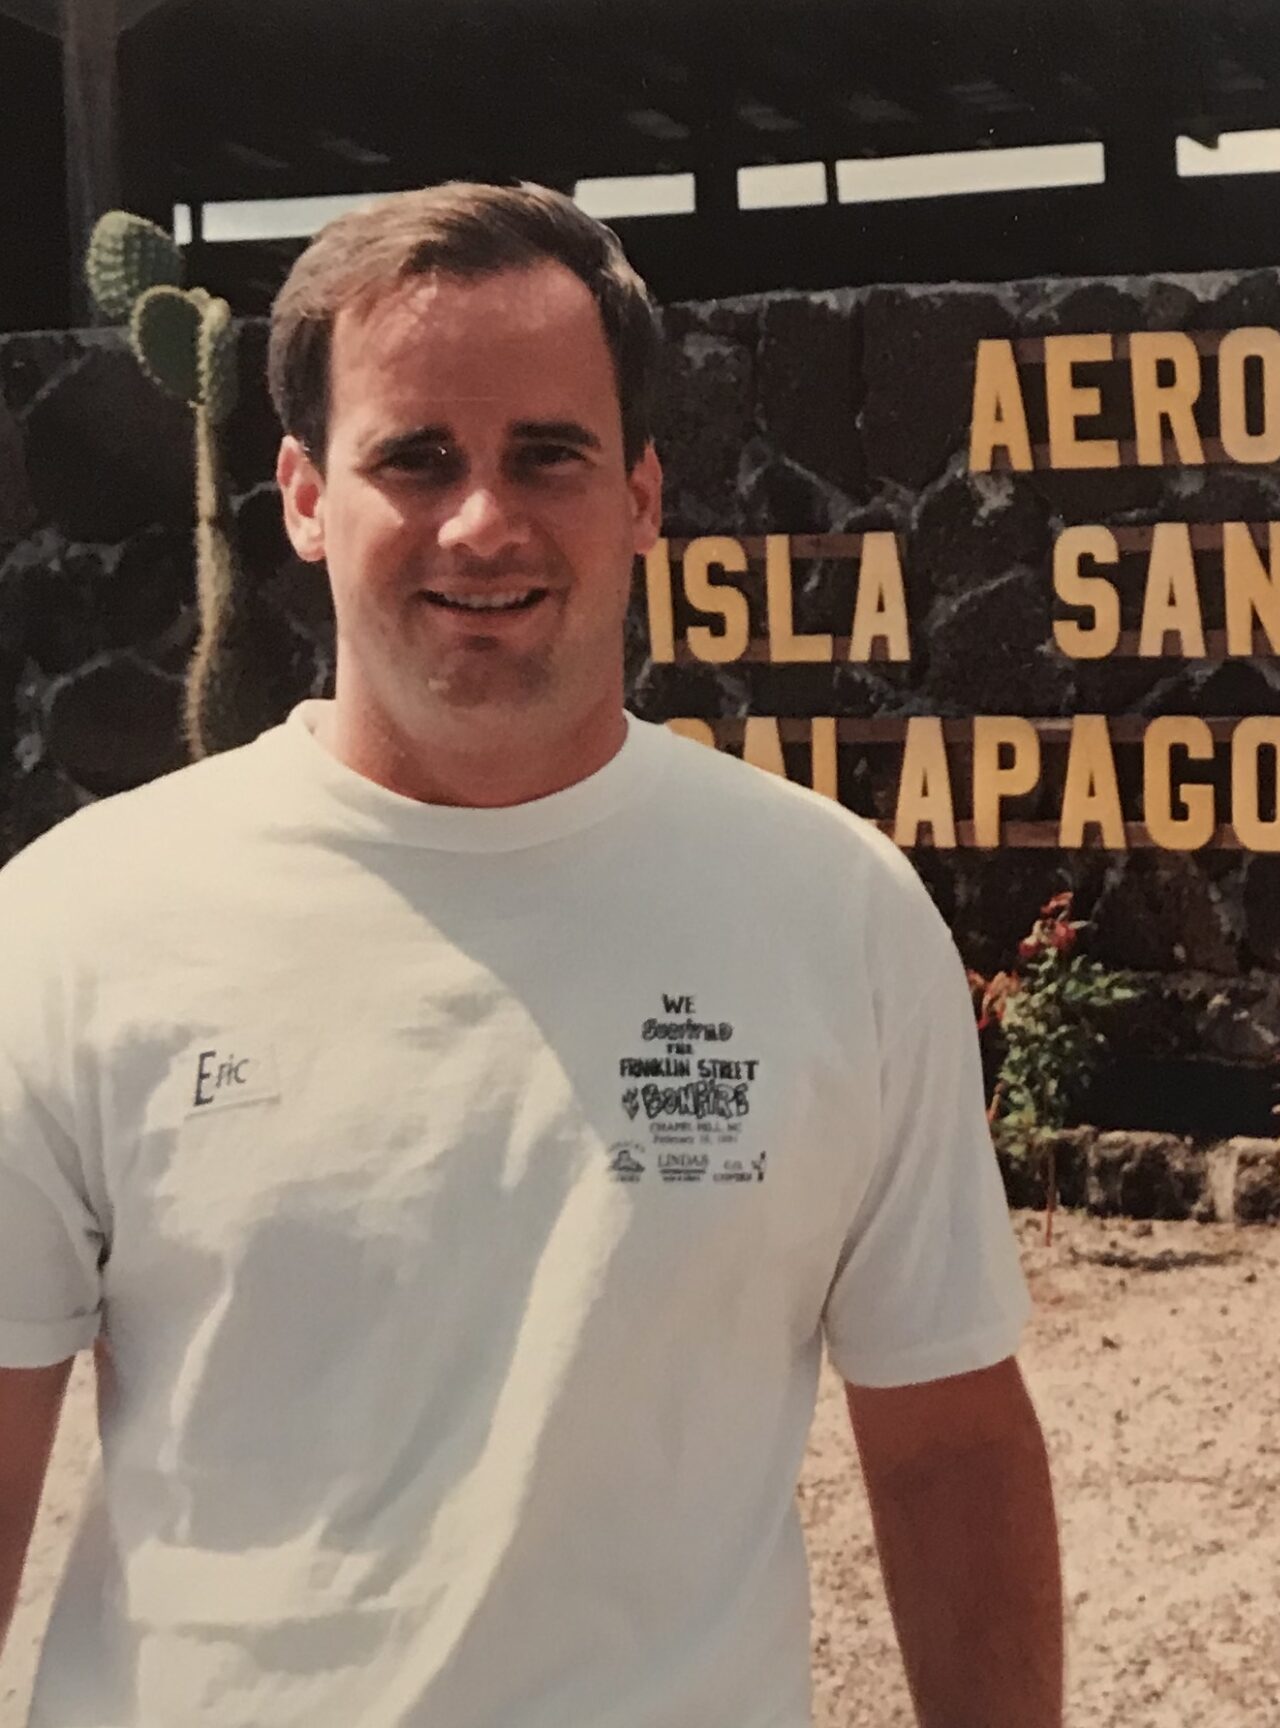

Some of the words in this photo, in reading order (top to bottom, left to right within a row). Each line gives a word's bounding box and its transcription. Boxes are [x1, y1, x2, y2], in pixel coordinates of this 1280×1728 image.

[645, 531, 911, 663] ISLA
[662, 993, 696, 1014] WE
[194, 1051, 249, 1107] Eric
[619, 1057, 690, 1078] FRANKLIN
[697, 1058, 759, 1081] STREET
